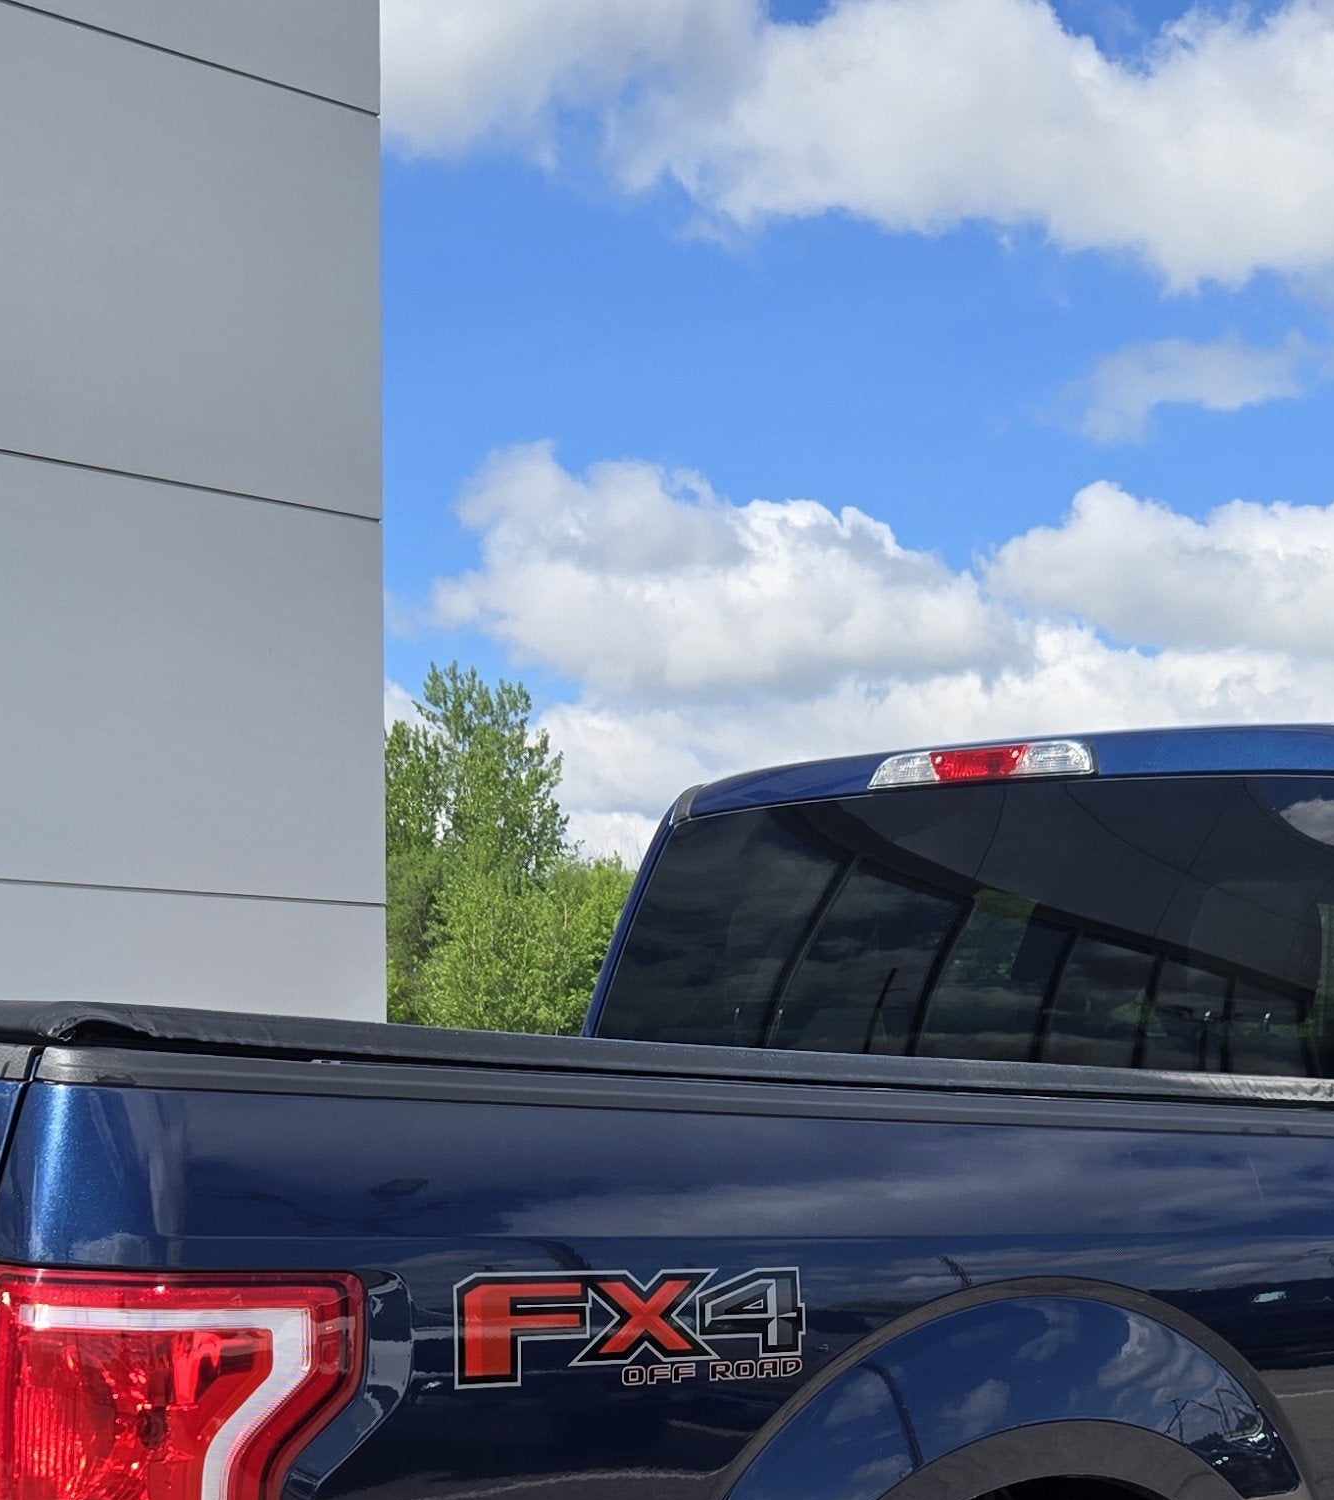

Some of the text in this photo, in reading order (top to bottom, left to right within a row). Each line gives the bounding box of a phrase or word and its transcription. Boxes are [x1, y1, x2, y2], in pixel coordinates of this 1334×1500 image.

[453, 1266, 806, 1390] FX4
[622, 1357, 803, 1386] OFF ROAD
